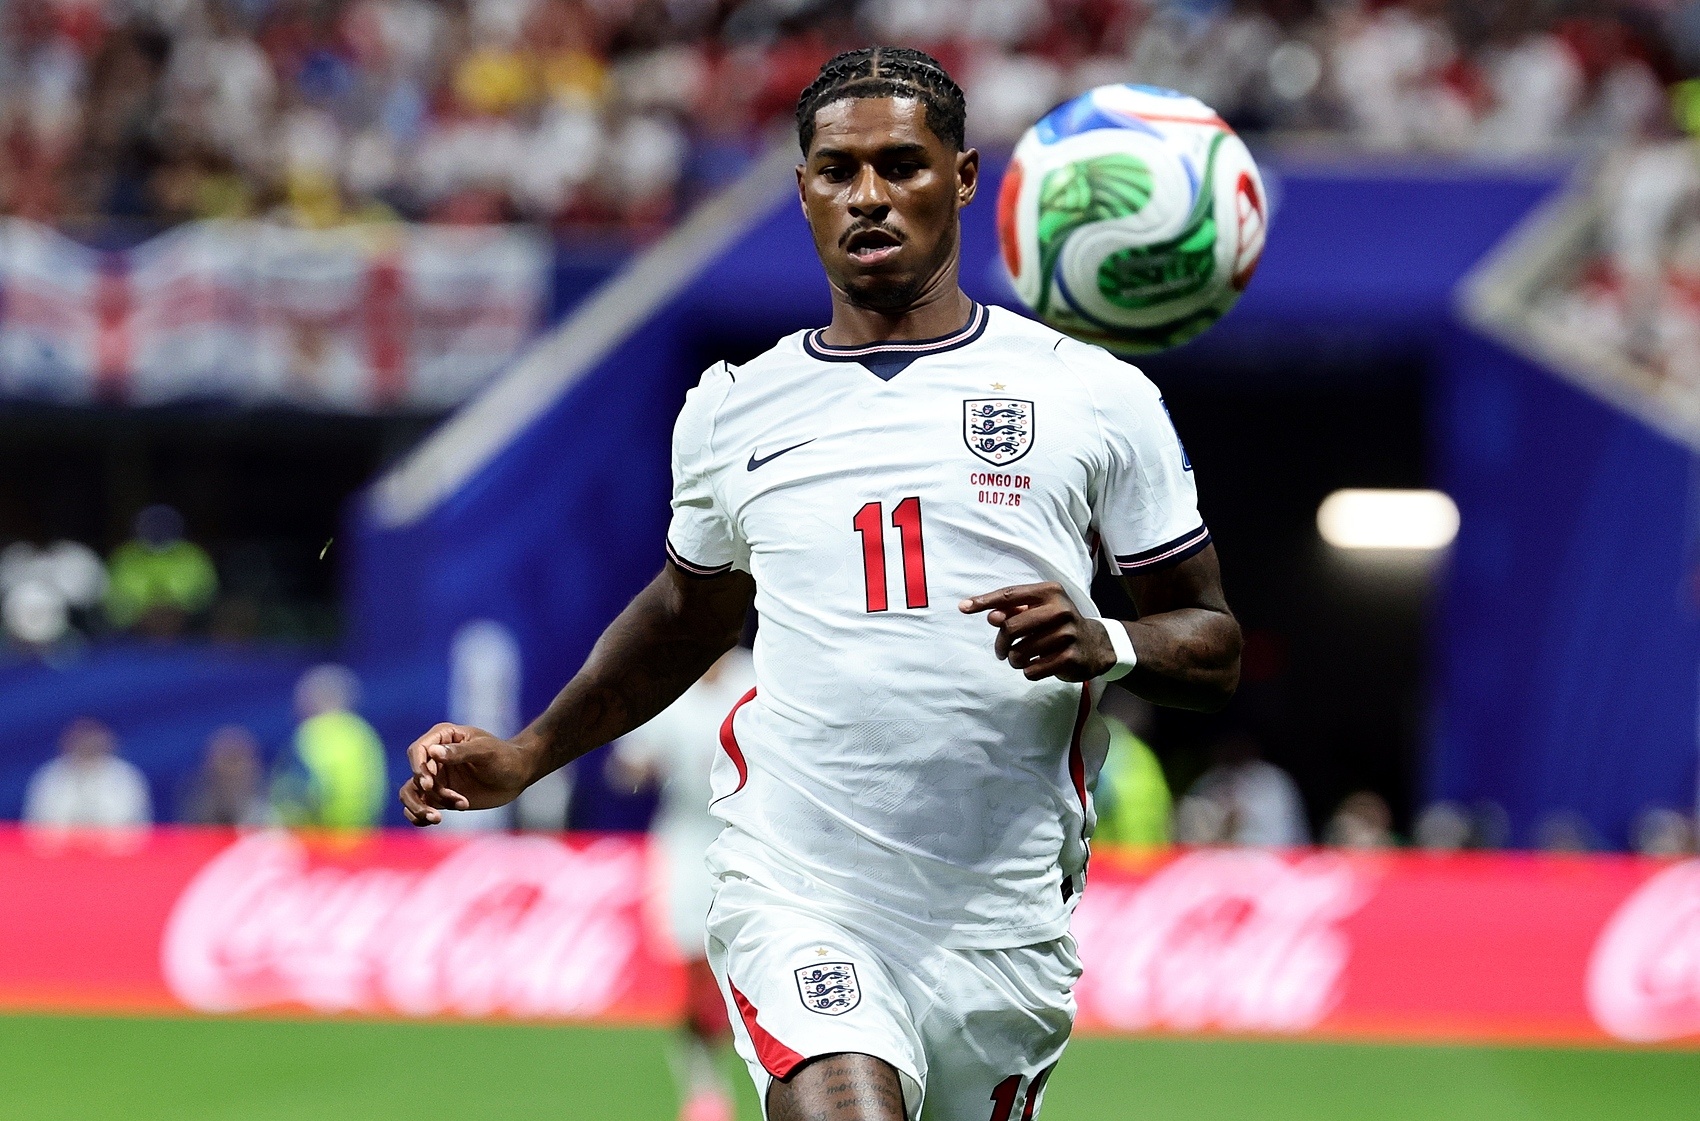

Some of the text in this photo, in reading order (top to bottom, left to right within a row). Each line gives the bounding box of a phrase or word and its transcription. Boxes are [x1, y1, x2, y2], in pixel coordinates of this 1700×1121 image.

[970, 472, 1030, 490] CONGO DR
[978, 490, 1021, 507] 01.07.26
[853, 496, 929, 613] 11
